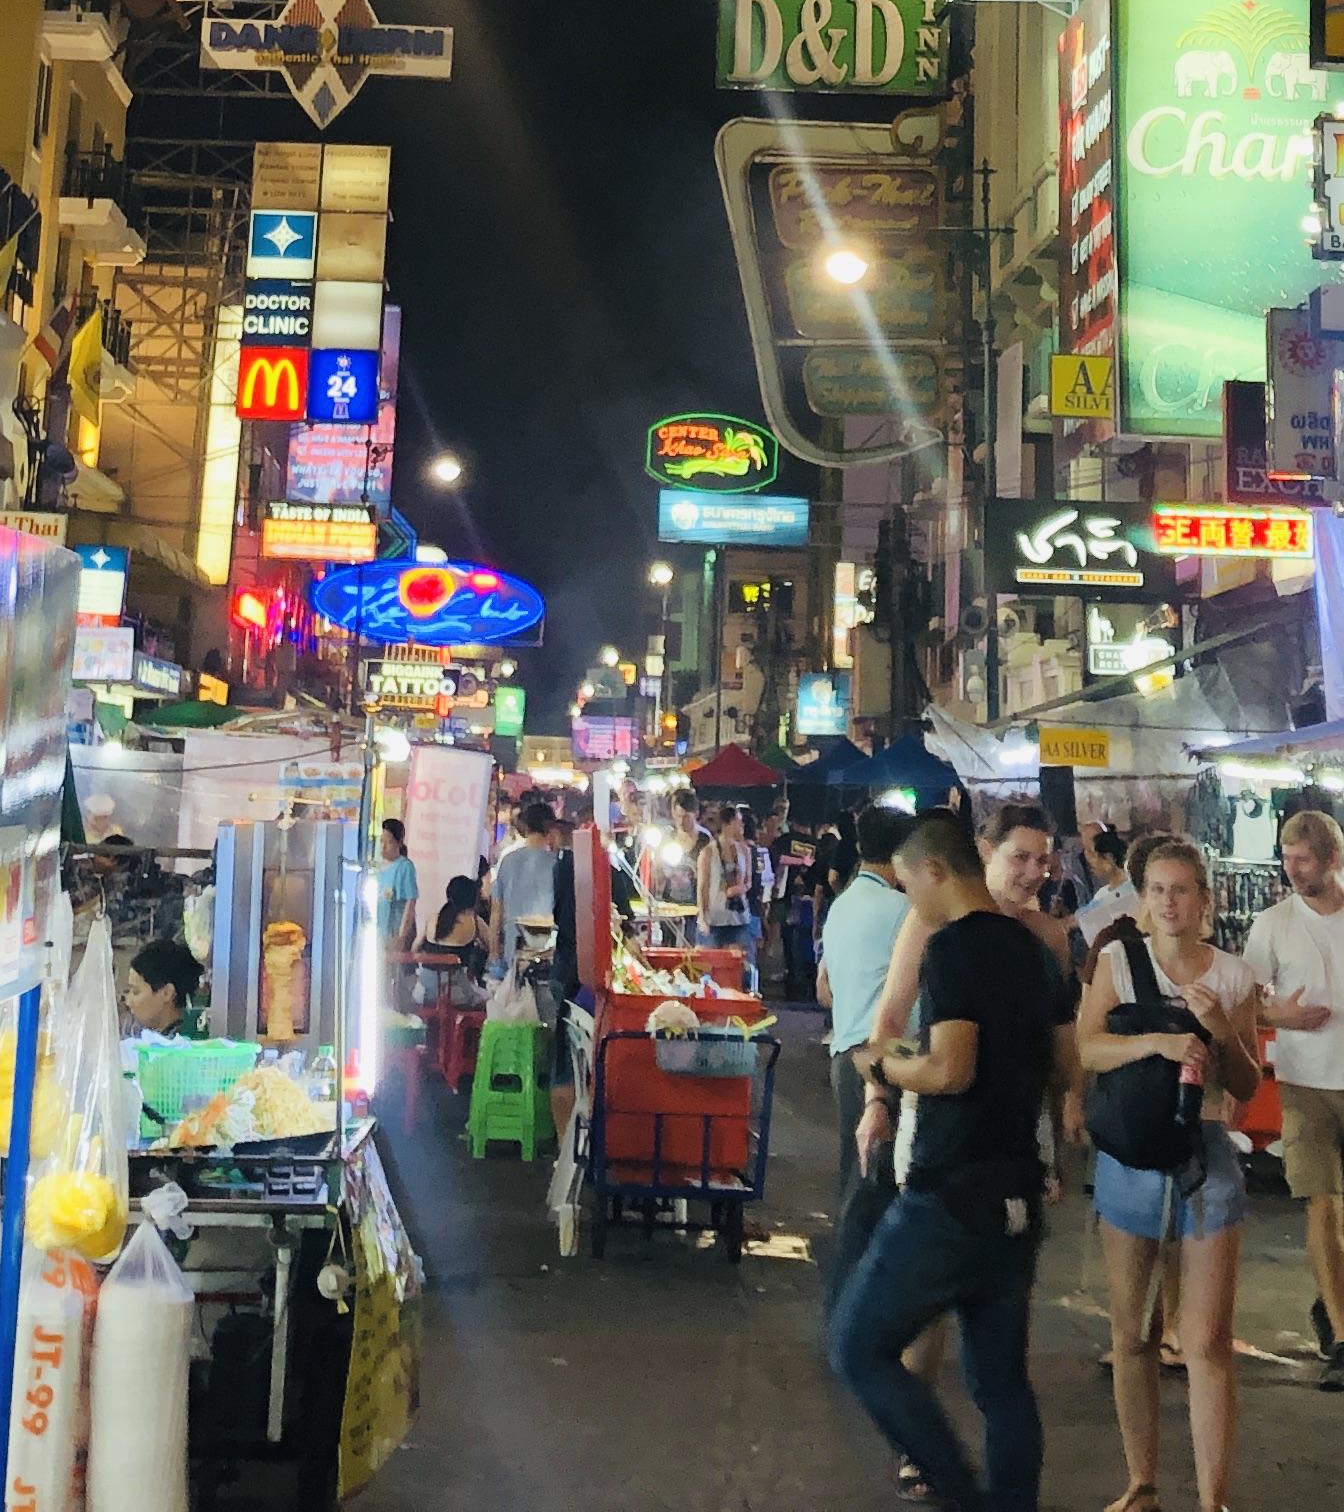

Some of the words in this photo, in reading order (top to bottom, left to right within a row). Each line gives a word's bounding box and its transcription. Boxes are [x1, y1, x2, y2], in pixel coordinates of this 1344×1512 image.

[244, 294, 312, 311] DOCTOR
[243, 314, 310, 336] CLINIC
[326, 374, 357, 398] 24
[271, 506, 312, 521] TASTE
[332, 507, 371, 523] INDIA
[369, 674, 457, 696] TATTOO
[1063, 740, 1107, 760] SILVER
[22, 1324, 65, 1436] JT-99
